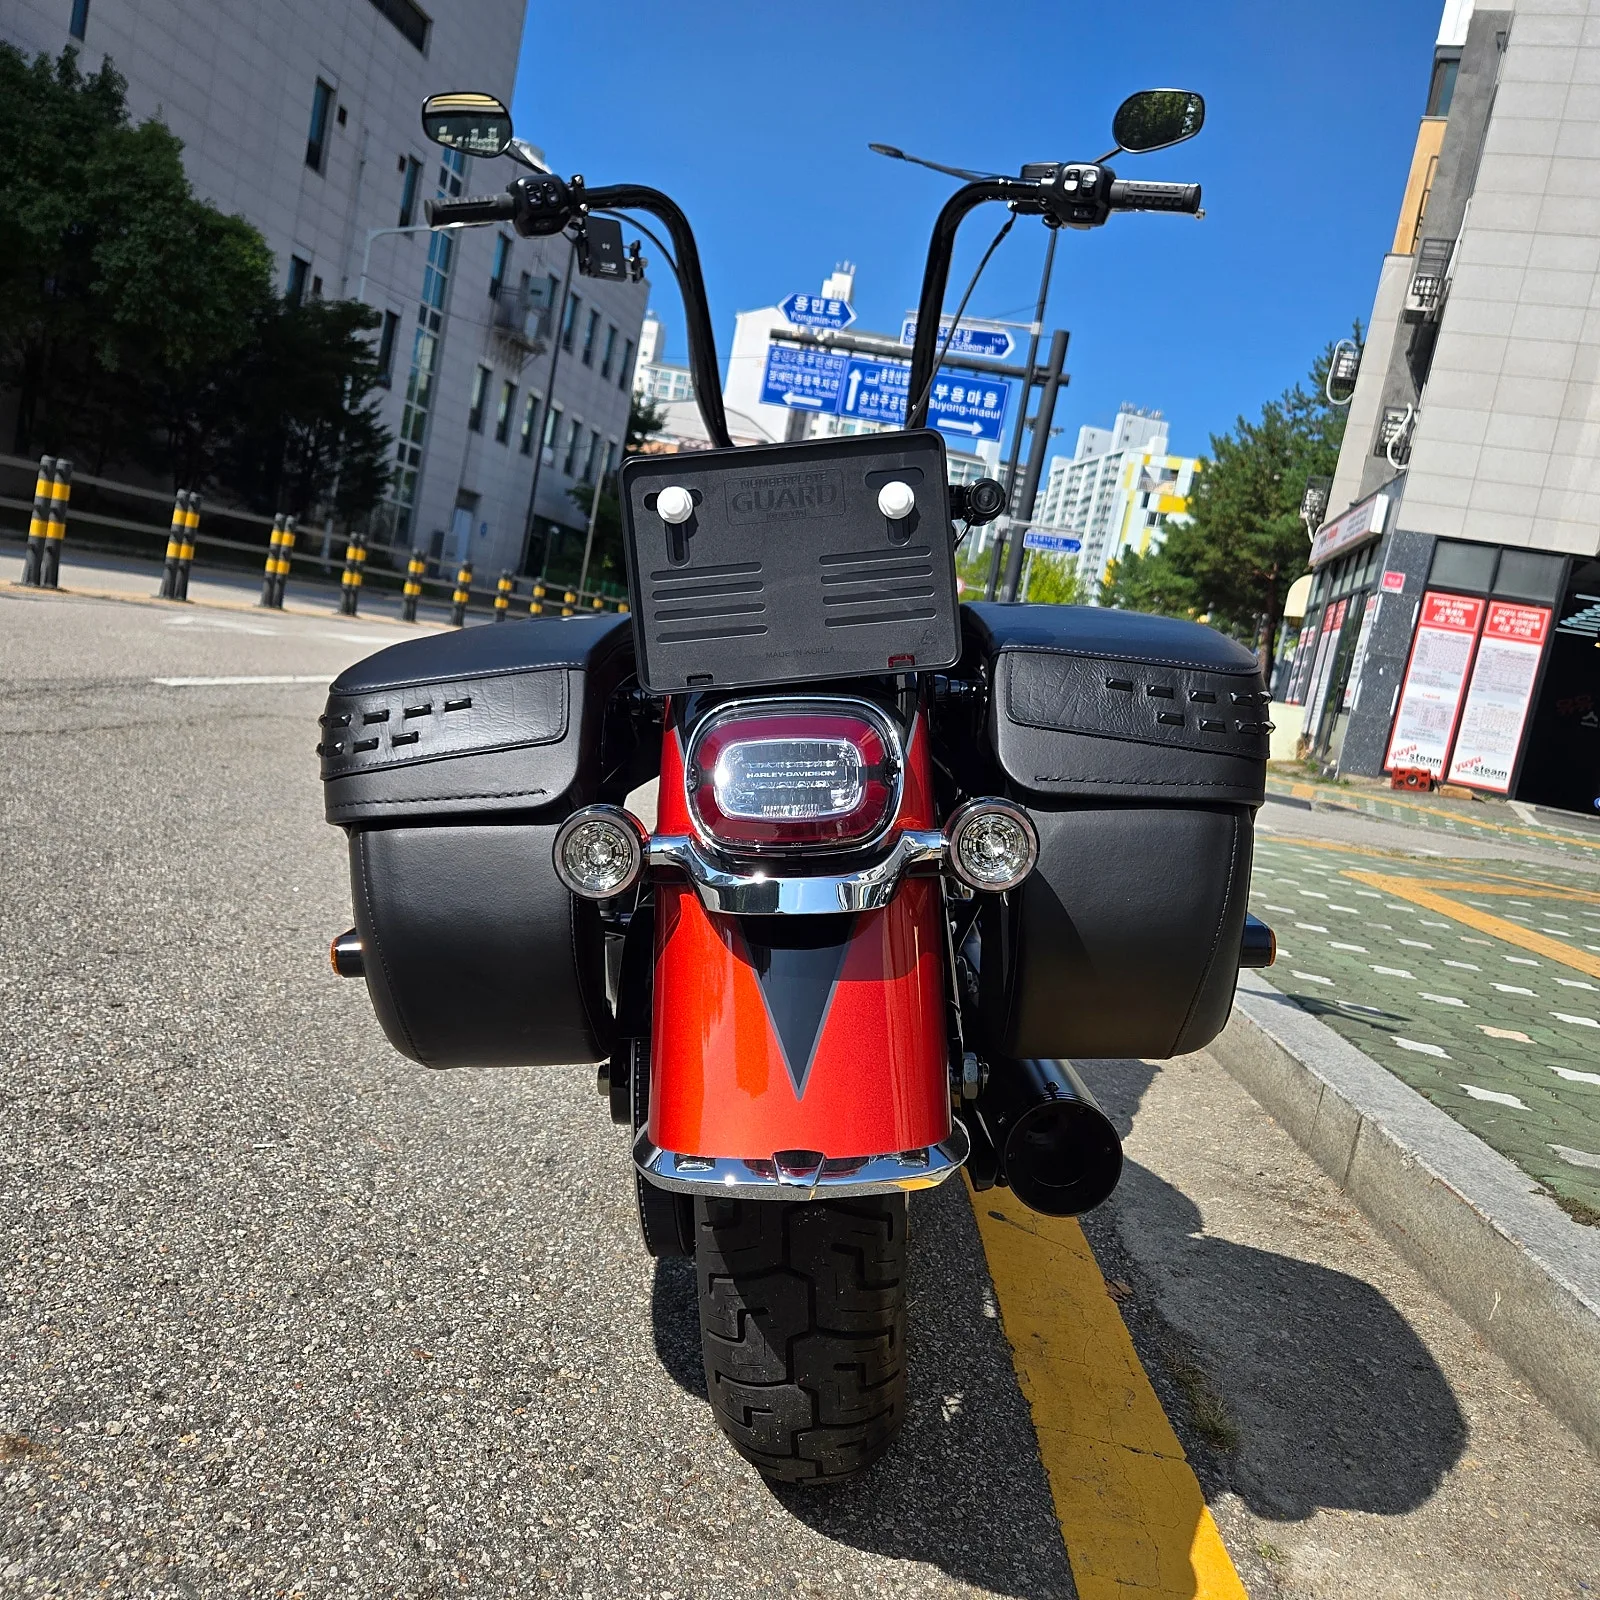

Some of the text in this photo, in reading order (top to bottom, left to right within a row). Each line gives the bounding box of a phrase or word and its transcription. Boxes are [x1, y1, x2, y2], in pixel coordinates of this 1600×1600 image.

[794, 296, 842, 316] 용민로
[790, 310, 842, 327] Yongmin-ro
[934, 383, 998, 409] 부용마을
[928, 398, 1001, 420] Buyong-maeul
[740, 470, 827, 489] NUMBERPLATE
[732, 484, 837, 513] GUARD
[765, 645, 835, 659] MADE IN KOREA
[1390, 744, 1418, 760] yuyu
[1409, 752, 1442, 766] steam
[1454, 755, 1483, 773] yuyu
[1473, 764, 1508, 778] steam
[746, 770, 837, 779] HARLEY-DAVIDSON
